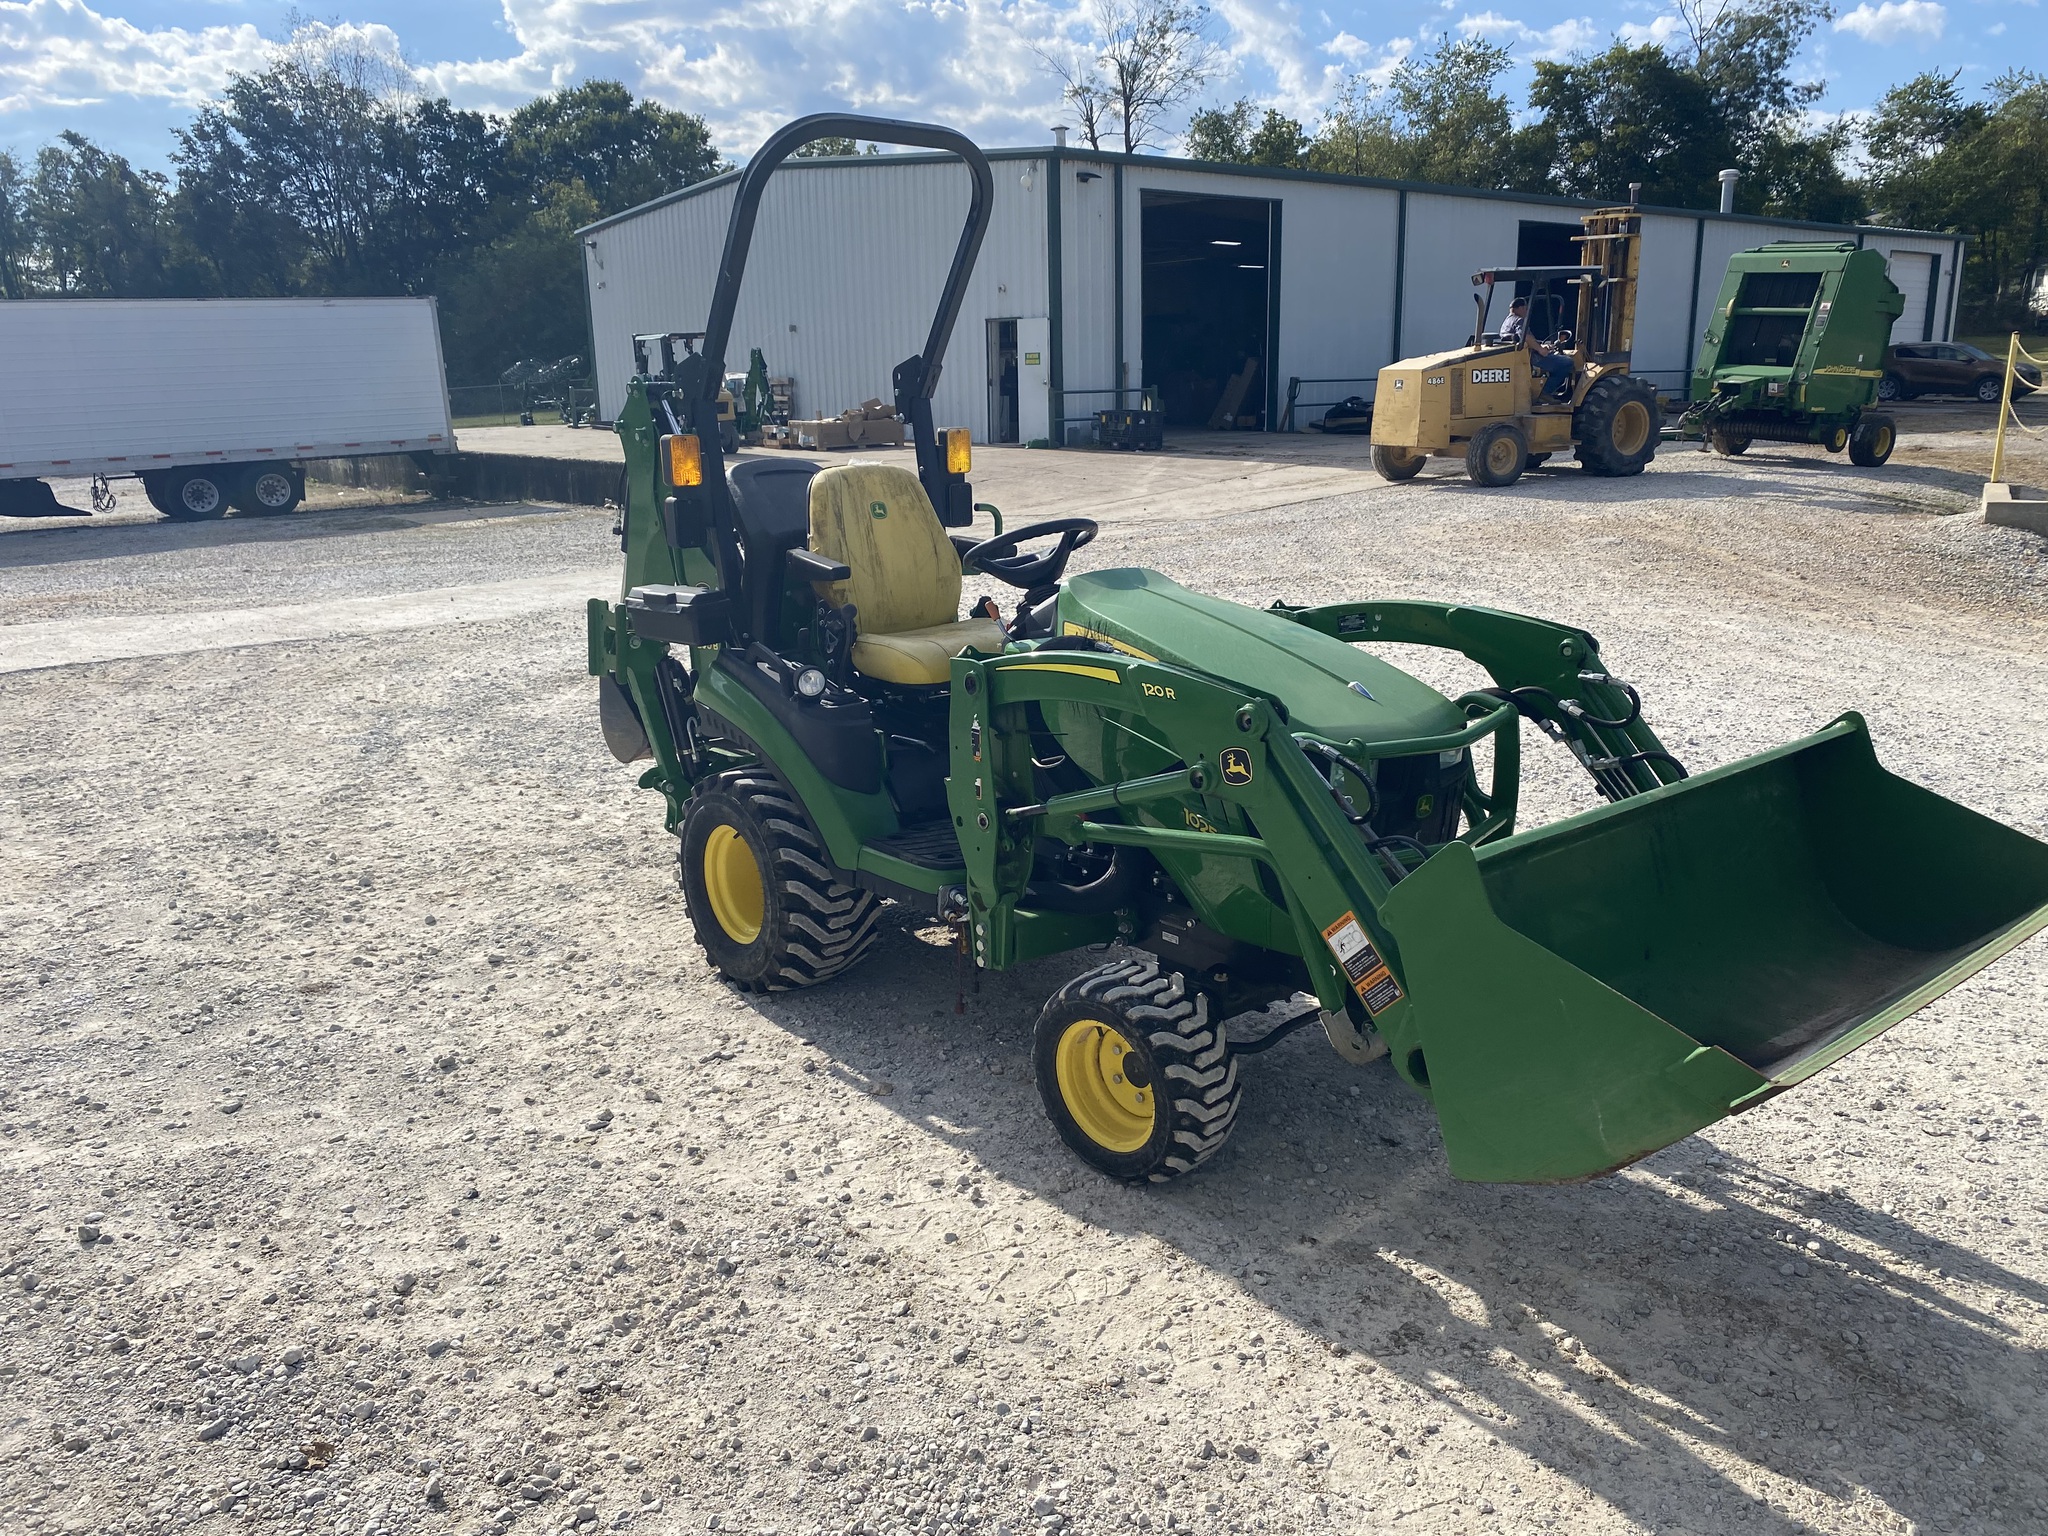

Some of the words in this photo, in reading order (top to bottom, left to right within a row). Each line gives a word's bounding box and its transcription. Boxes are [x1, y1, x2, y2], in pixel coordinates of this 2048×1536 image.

[1472, 369, 1510, 383] DEERE
[1331, 915, 1351, 933] WARNING
[1366, 971, 1387, 987] WARNING
